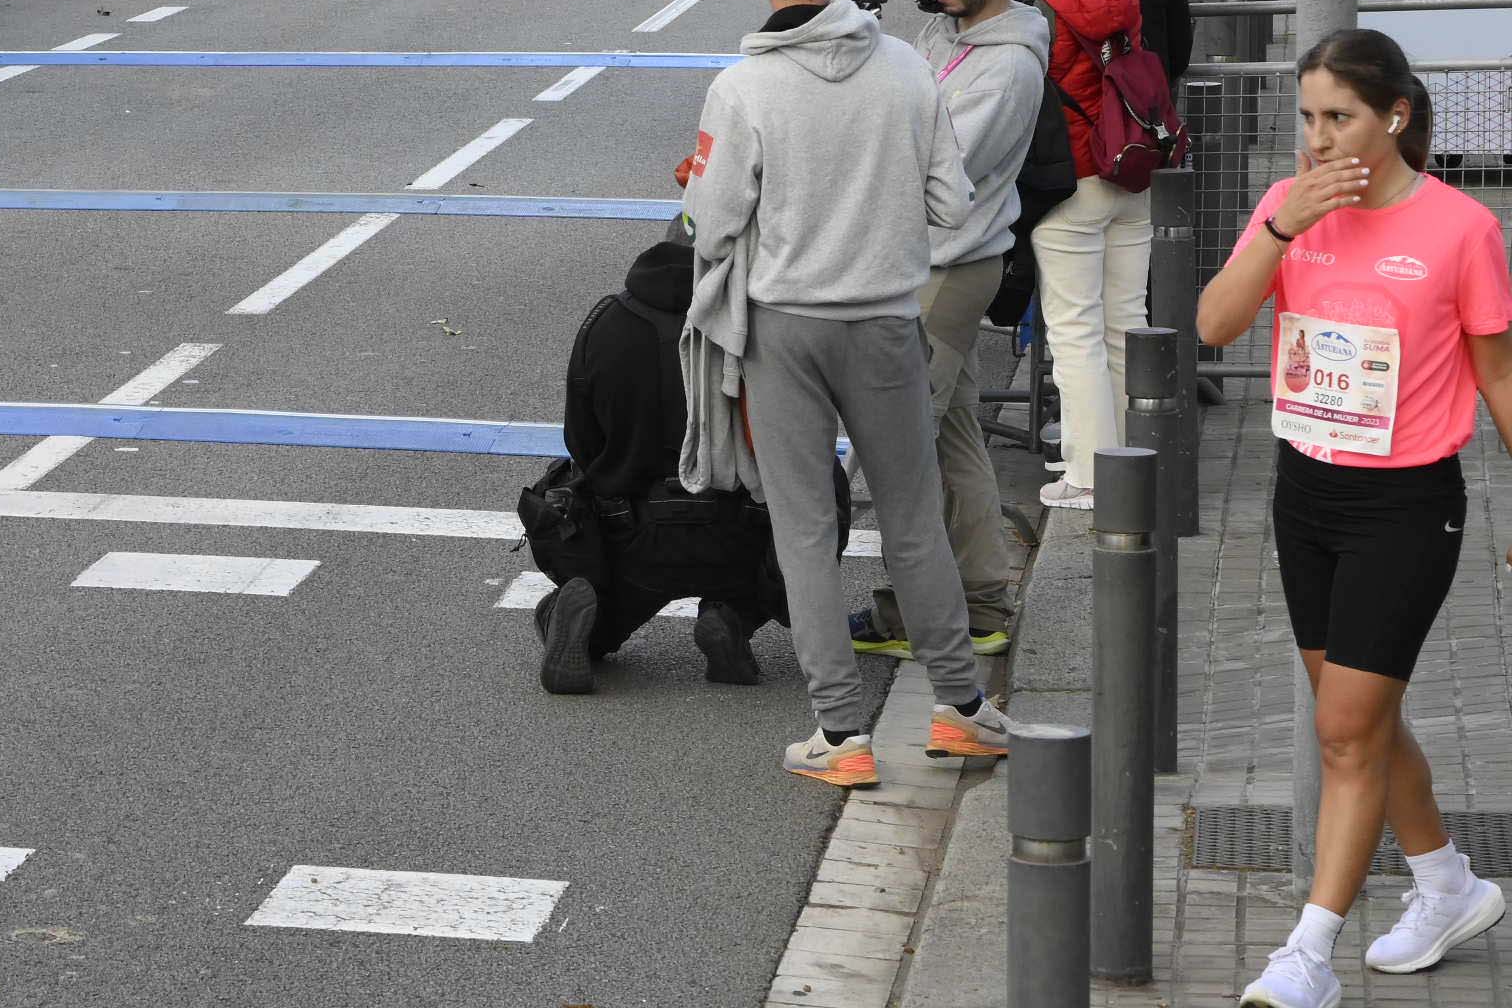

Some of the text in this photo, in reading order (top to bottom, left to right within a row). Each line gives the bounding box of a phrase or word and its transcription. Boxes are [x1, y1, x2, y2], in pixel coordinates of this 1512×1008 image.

[1314, 368, 1350, 391] 016
[1313, 392, 1343, 407] 32280
[1281, 419, 1312, 434] OYSHO
